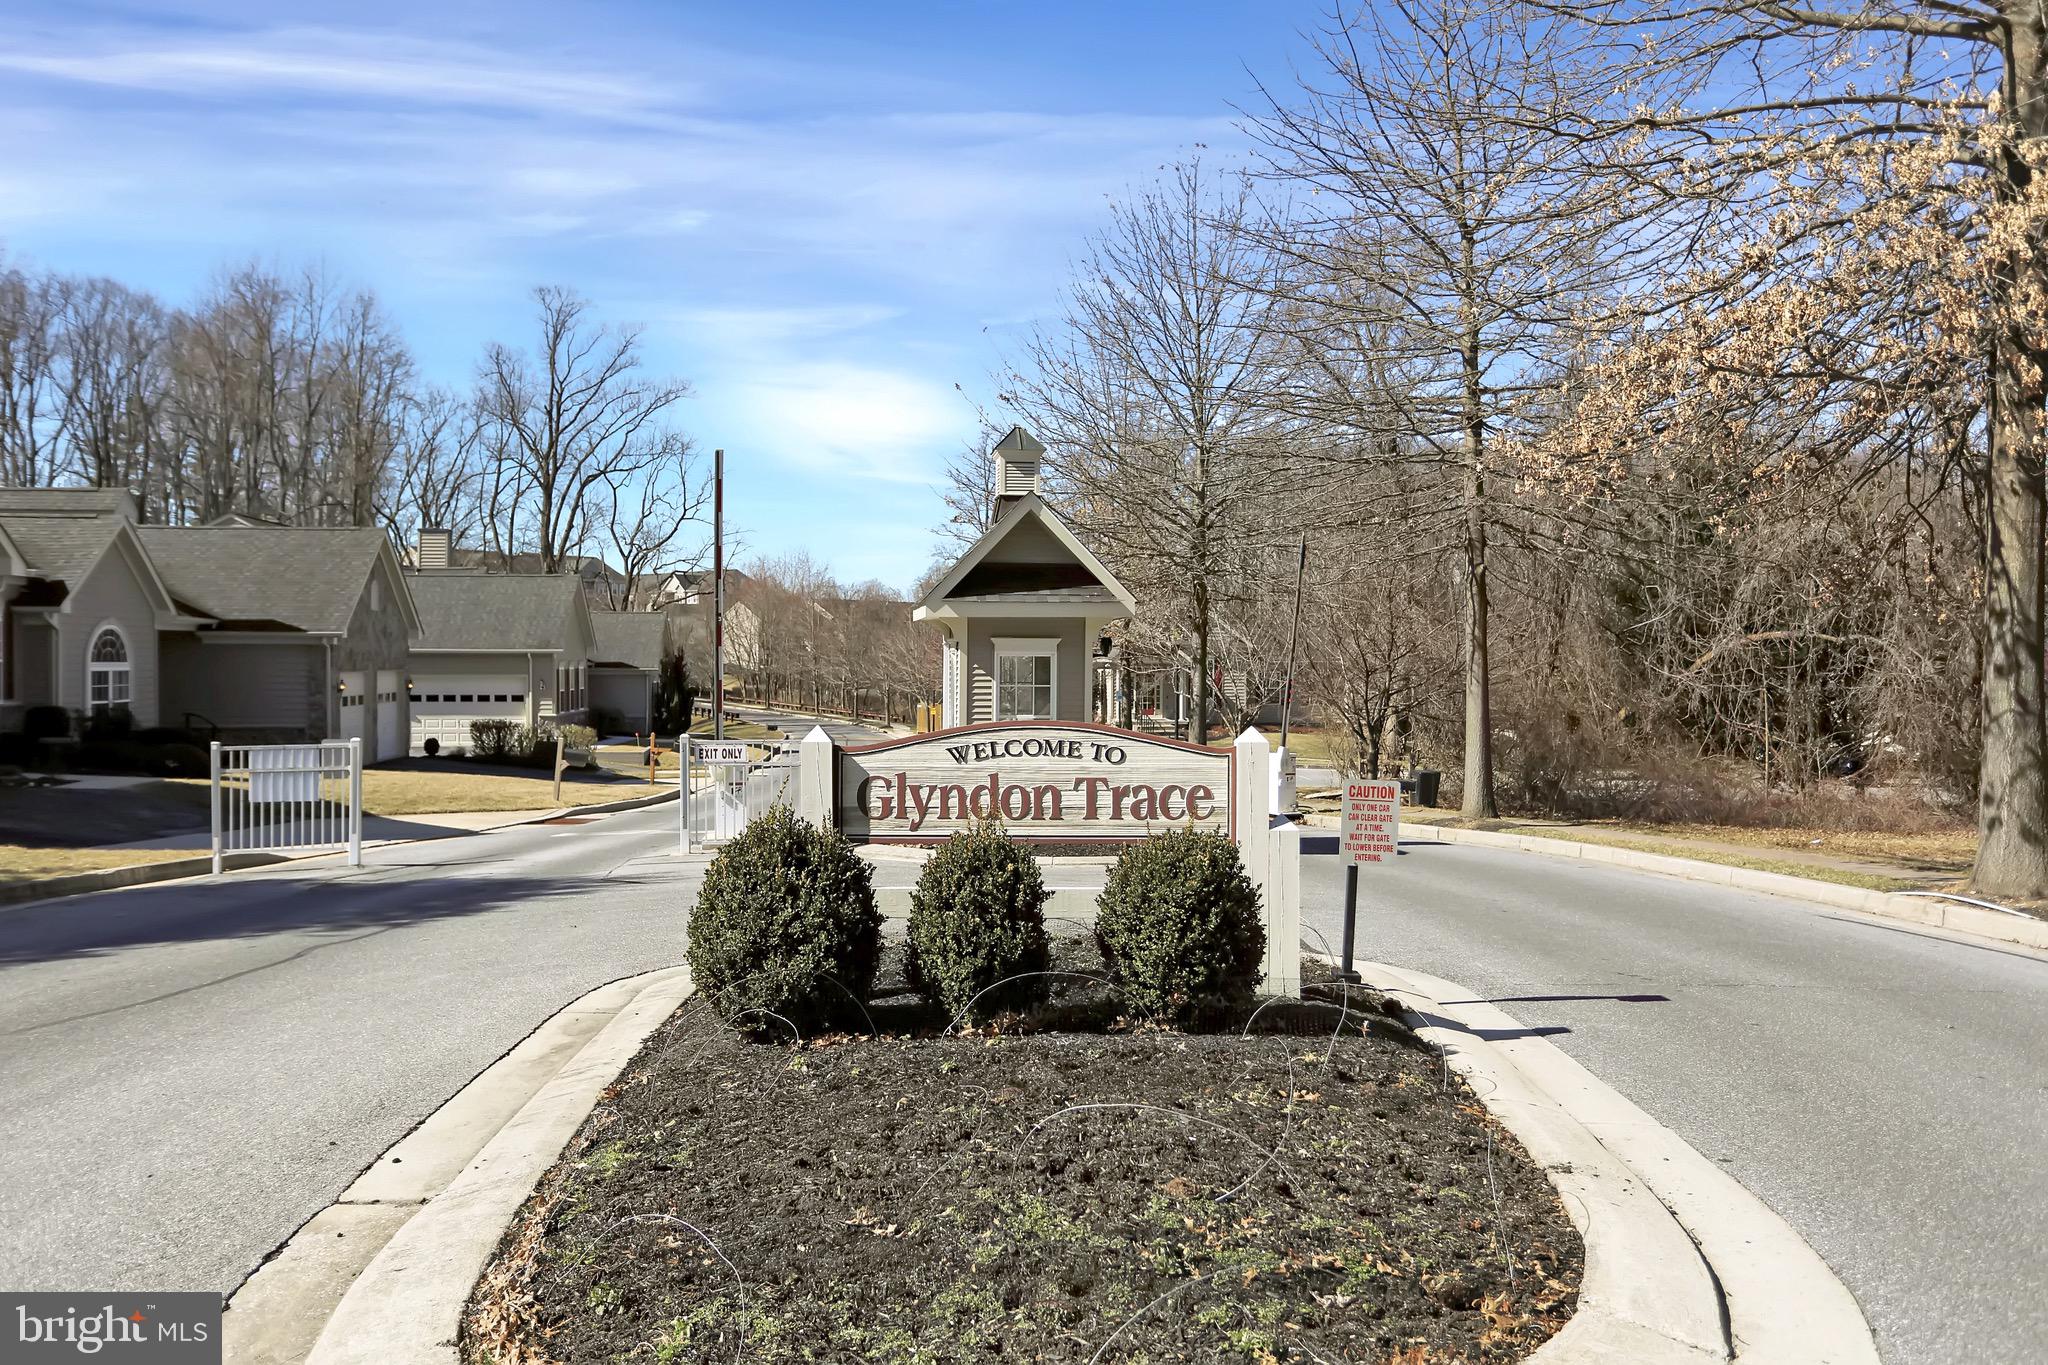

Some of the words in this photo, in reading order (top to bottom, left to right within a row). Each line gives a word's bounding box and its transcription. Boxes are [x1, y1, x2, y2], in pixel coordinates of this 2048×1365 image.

[698, 748, 718, 760] EXIT
[721, 748, 743, 760] ONLY
[945, 739, 1083, 765] WELCOME
[1090, 742, 1127, 765] TO
[1348, 785, 1395, 799] CAUTION
[856, 771, 1064, 832] Glyndon
[1072, 777, 1216, 821] Trace
[1351, 802, 1366, 811] ONLY
[1366, 803, 1378, 812] ONE
[1378, 804, 1390, 813] CAR
[1348, 812, 1360, 821] CAN
[1360, 813, 1378, 822] CLEAR
[1378, 814, 1393, 823] GATE
[1355, 823, 1363, 831] AT
[1369, 824, 1384, 832] TIME.
[1349, 833, 1363, 841] WAIT
[1364, 833, 1375, 842] FOR
[1376, 834, 1390, 843] GATE
[1344, 842, 1352, 851] TO
[1352, 843, 1372, 852] LOWER
[1372, 844, 1394, 853] BEFORE
[1354, 853, 1382, 862] ENTERING.
